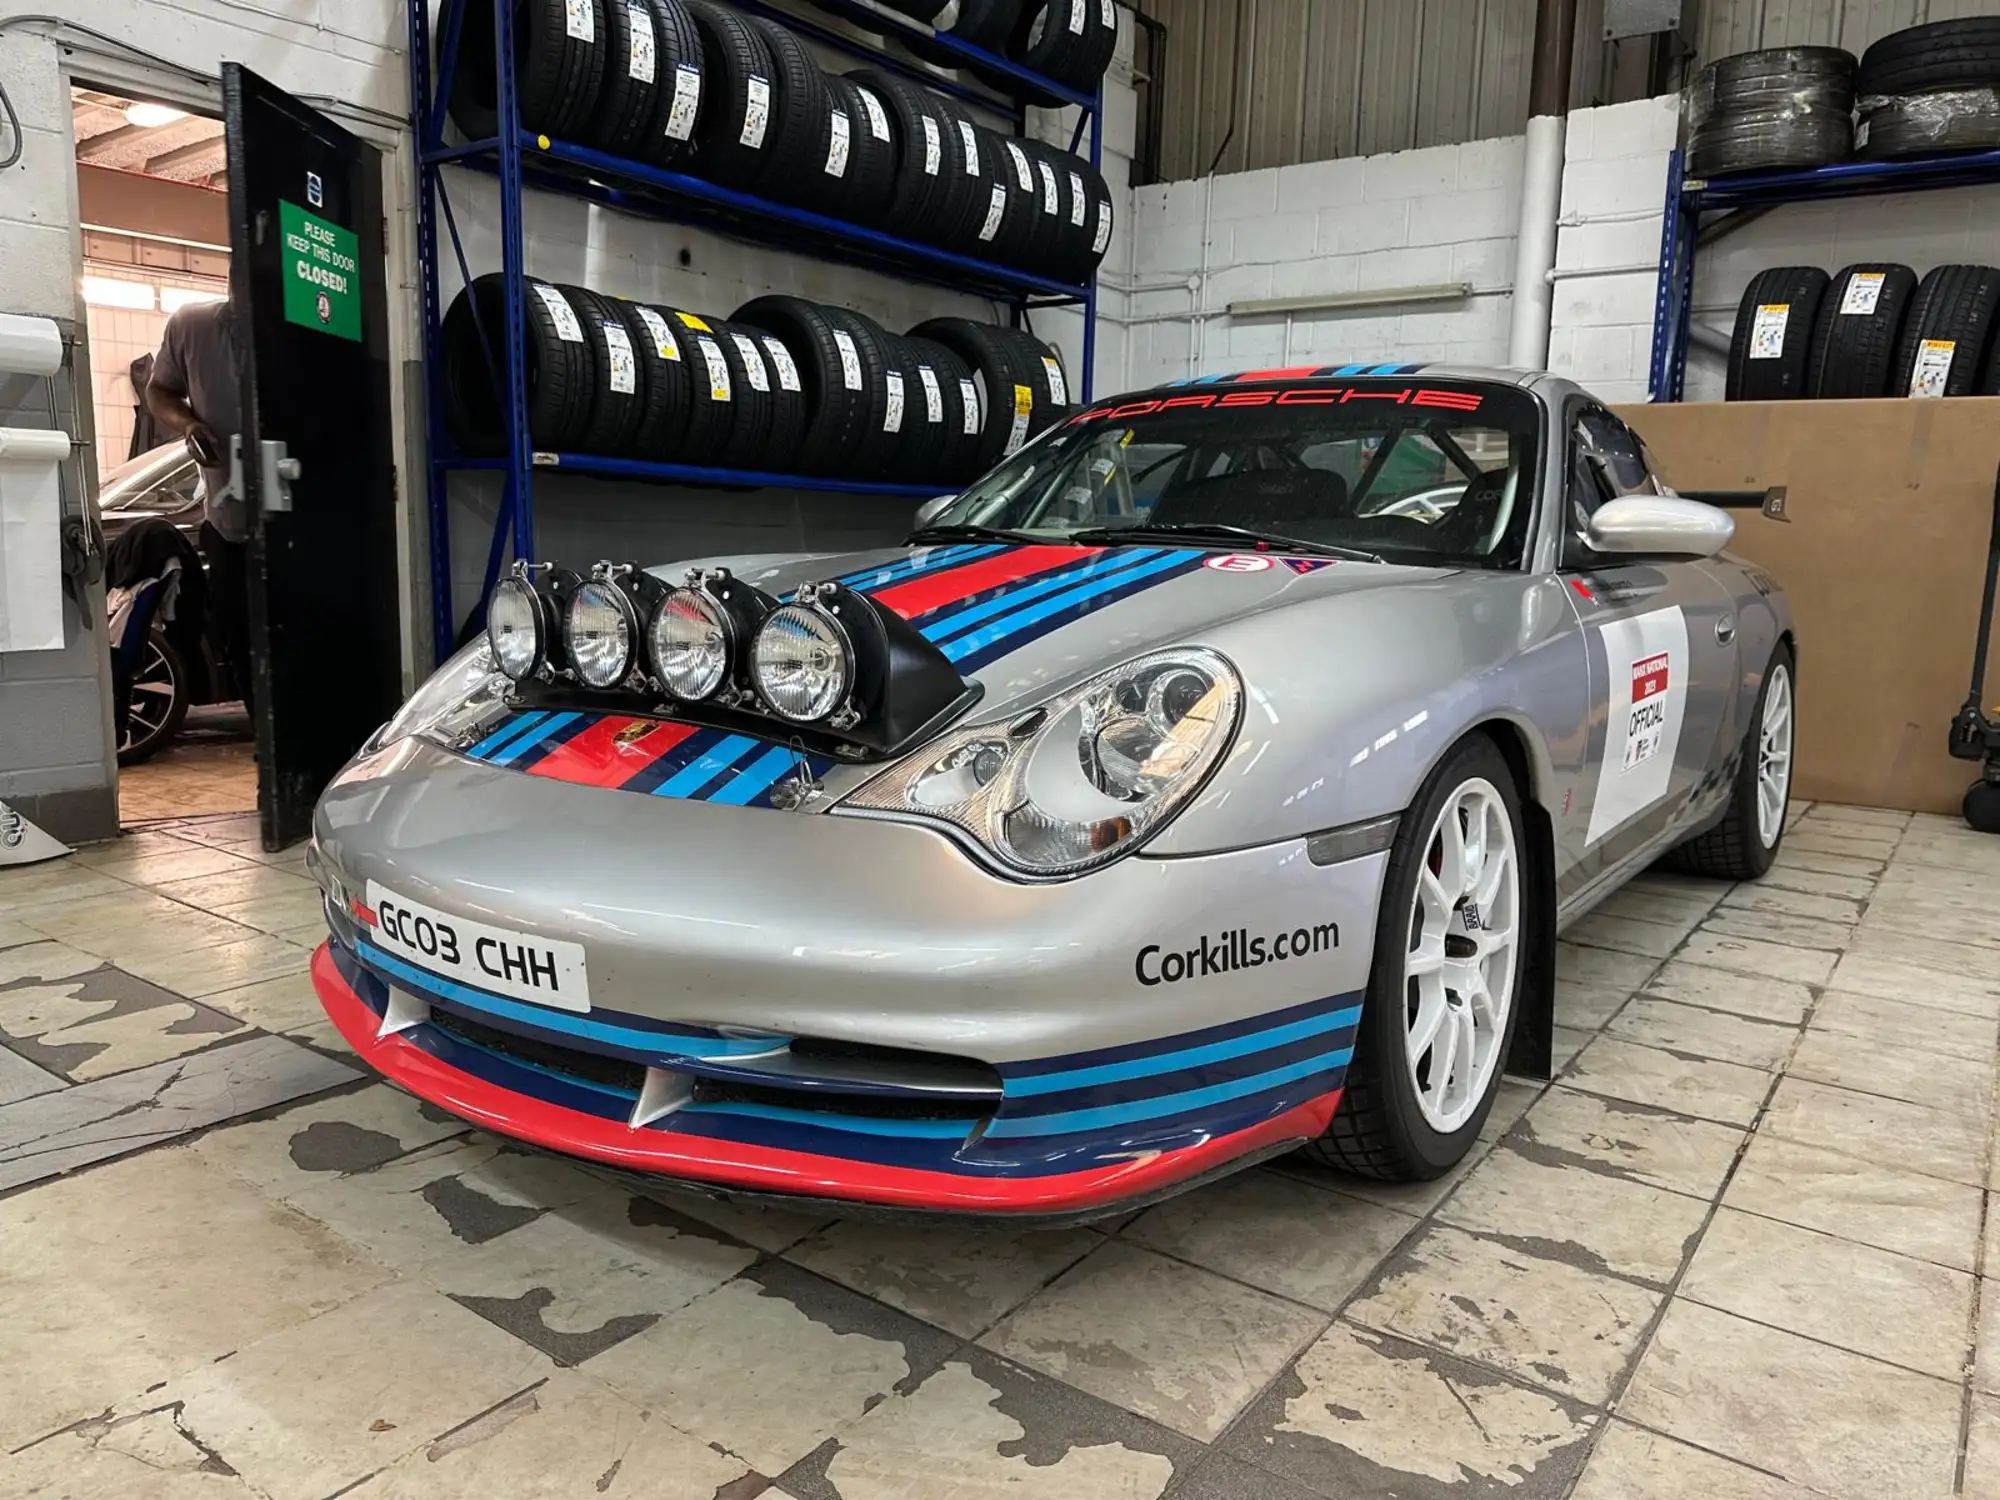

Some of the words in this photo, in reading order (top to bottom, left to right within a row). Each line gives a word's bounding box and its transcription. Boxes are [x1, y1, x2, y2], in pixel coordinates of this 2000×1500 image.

[287, 232, 310, 254] KEEP
[312, 244, 331, 263] THIS
[331, 252, 355, 273] DOOR
[304, 221, 336, 247] PLEASE
[297, 259, 348, 295] CLOSED!
[1063, 389, 1483, 429] PORSCHE
[1629, 700, 1663, 737] OFFICIAL
[380, 901, 460, 964] GC03
[475, 937, 559, 991] CHH
[1135, 922, 1339, 986] Corkills.com
